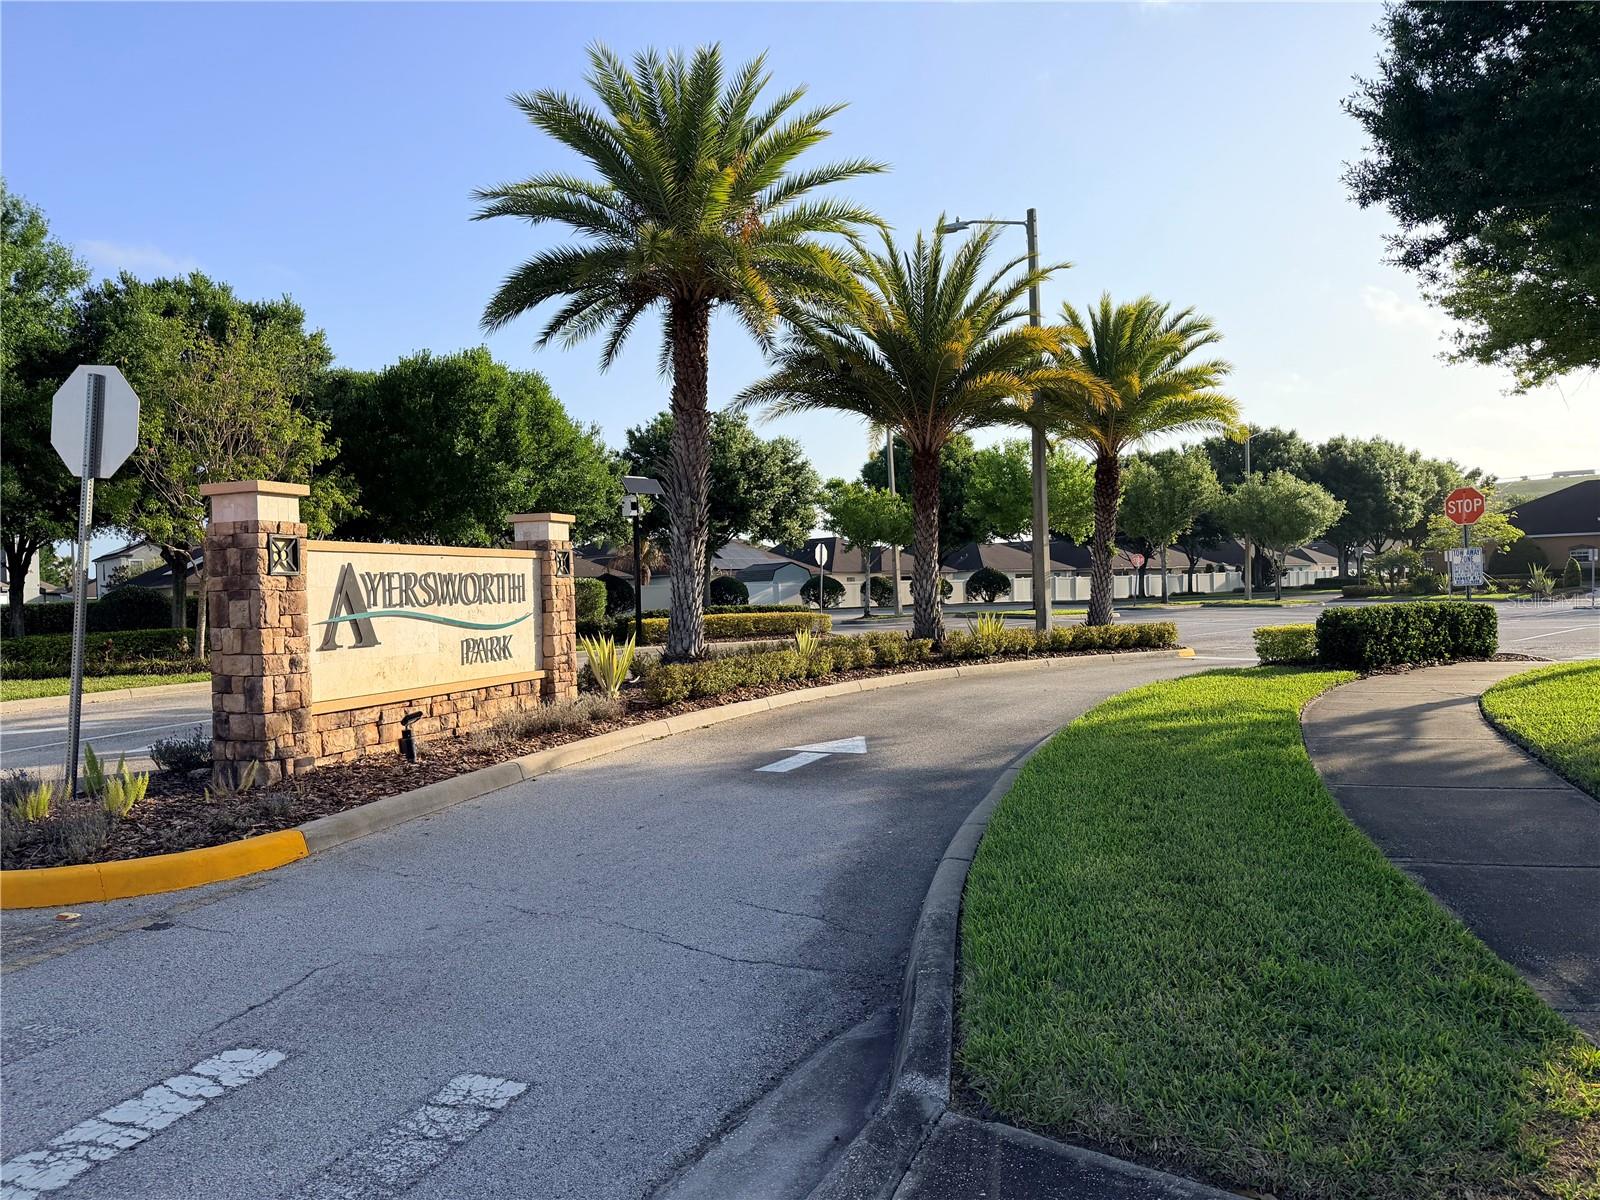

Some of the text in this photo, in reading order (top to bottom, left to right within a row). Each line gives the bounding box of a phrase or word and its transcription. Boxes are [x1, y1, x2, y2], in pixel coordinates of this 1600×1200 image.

[1448, 499, 1482, 514] STOP
[315, 562, 526, 651] AYERSWORTH
[461, 634, 513, 666] PARK
